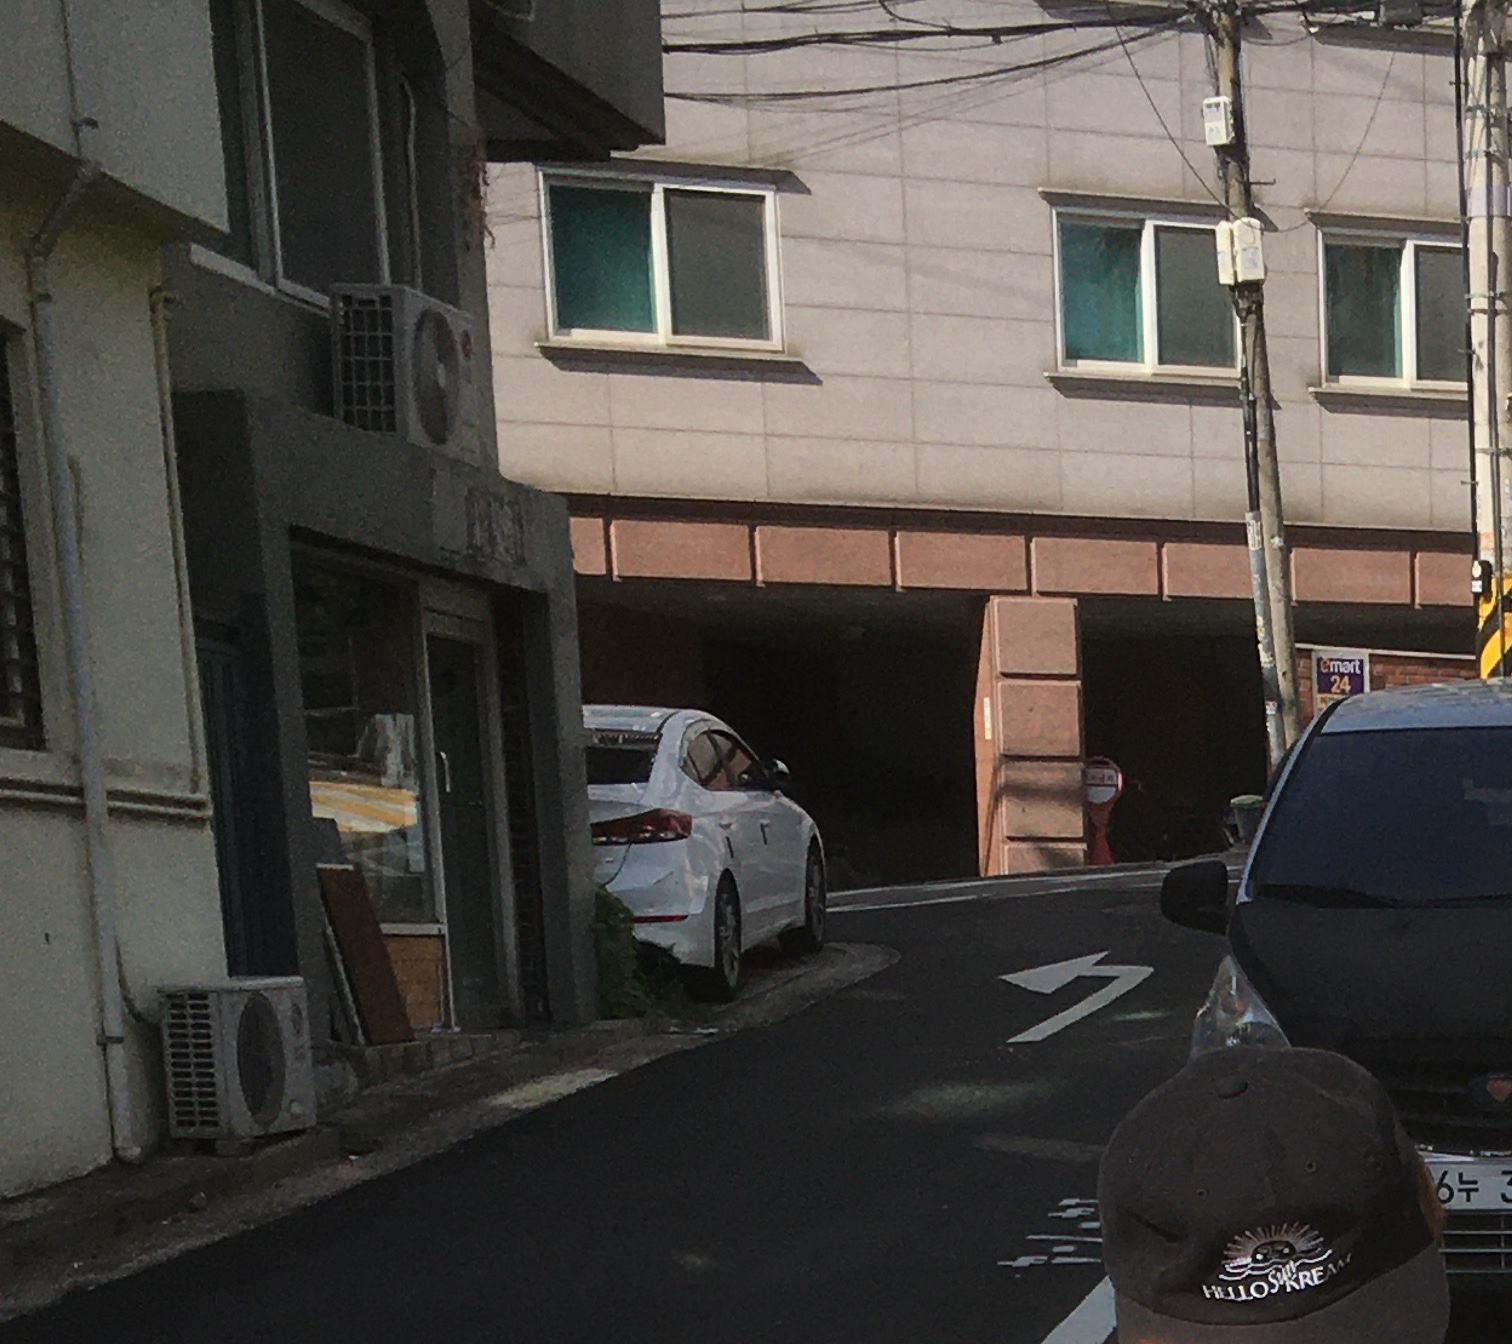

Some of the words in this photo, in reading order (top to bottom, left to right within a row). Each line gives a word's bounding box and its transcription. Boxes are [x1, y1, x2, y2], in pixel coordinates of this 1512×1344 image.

[1320, 657, 1361, 674] emart
[1330, 675, 1351, 694] 24
[1202, 1281, 1269, 1302] HELLO
